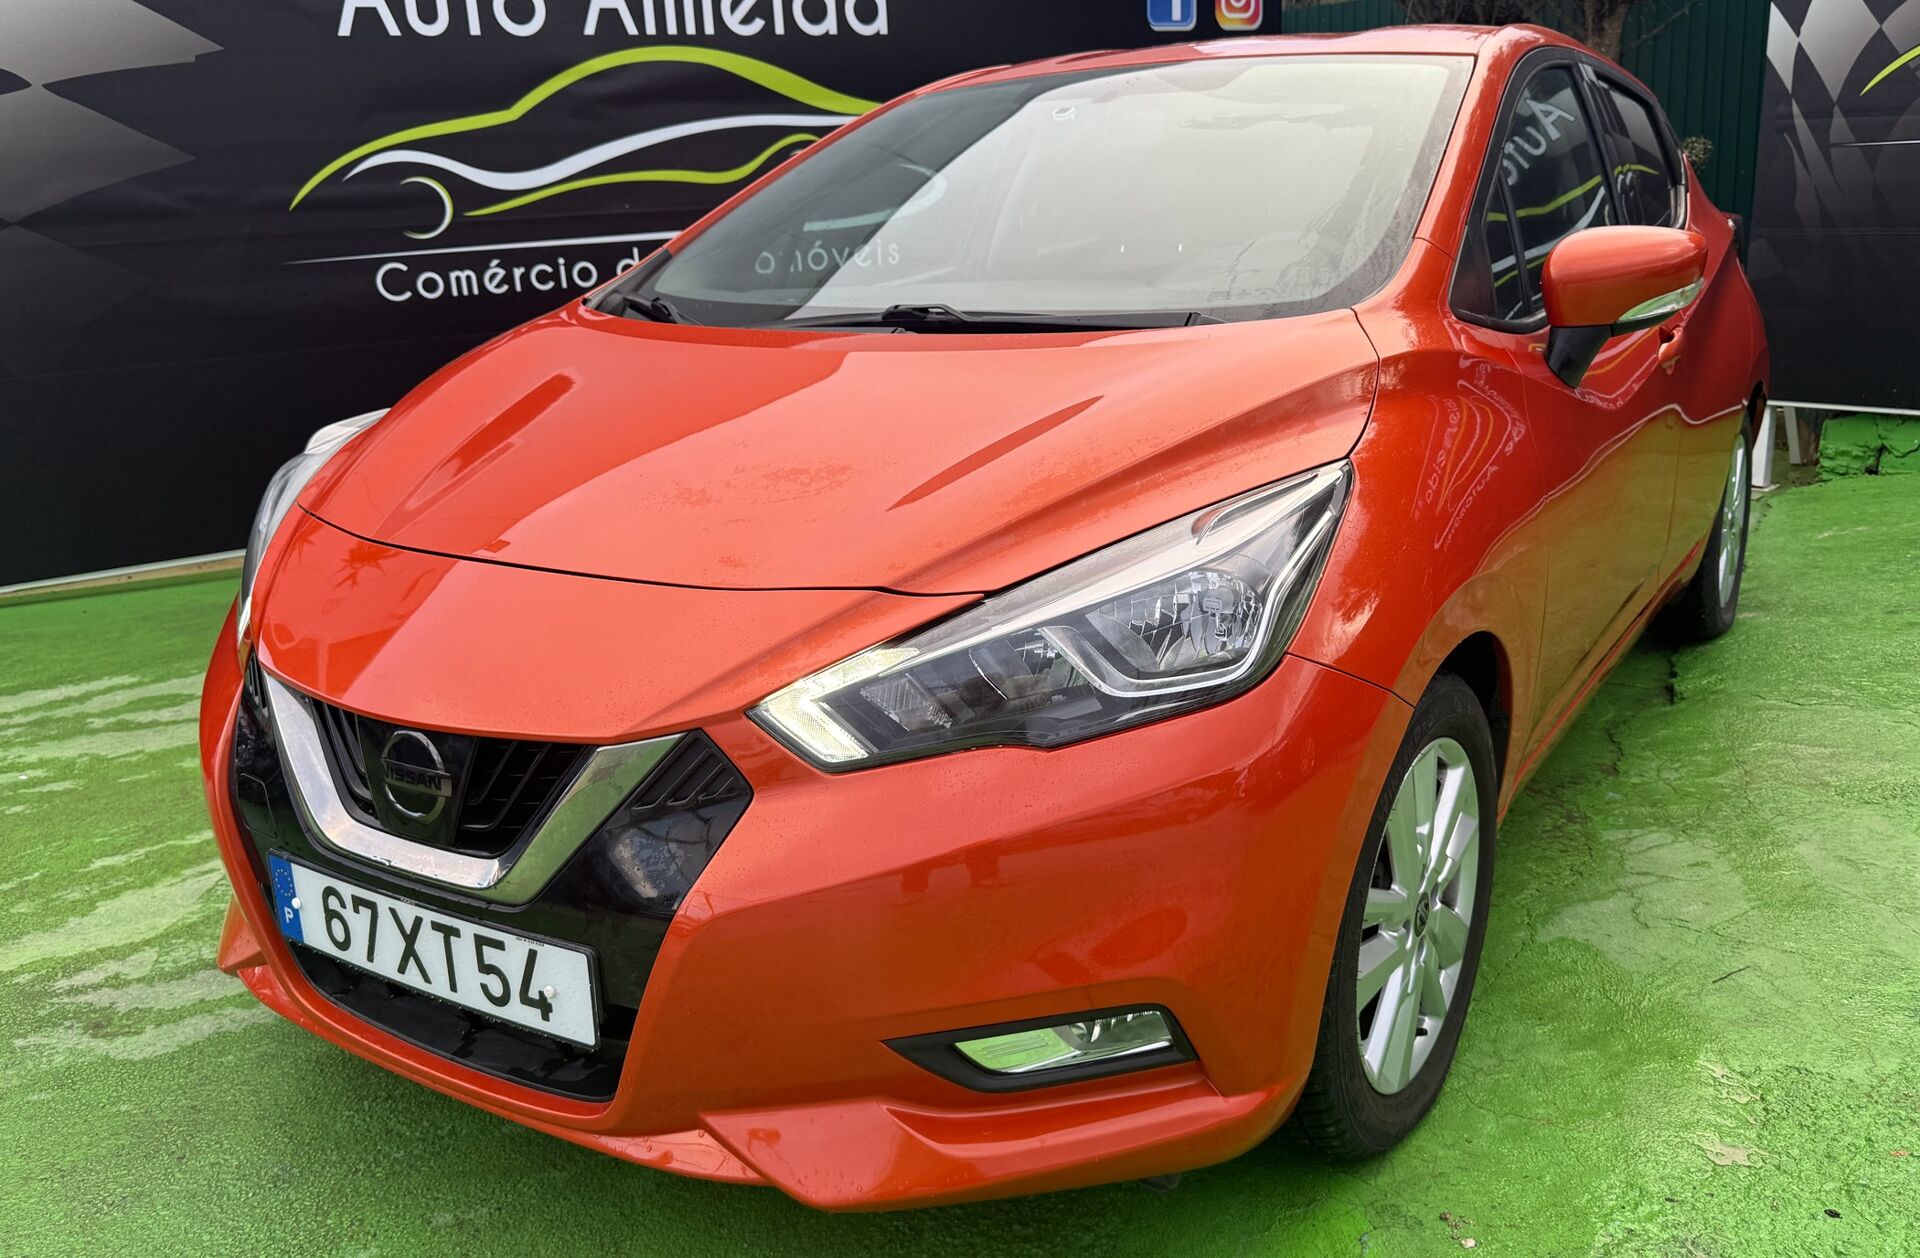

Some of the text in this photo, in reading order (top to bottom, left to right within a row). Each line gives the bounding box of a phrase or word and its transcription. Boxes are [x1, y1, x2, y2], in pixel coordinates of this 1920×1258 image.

[375, 257, 598, 301] Comércio
[383, 762, 443, 792] NISSAN
[284, 906, 294, 924] P
[321, 885, 554, 1023] 67XT54
